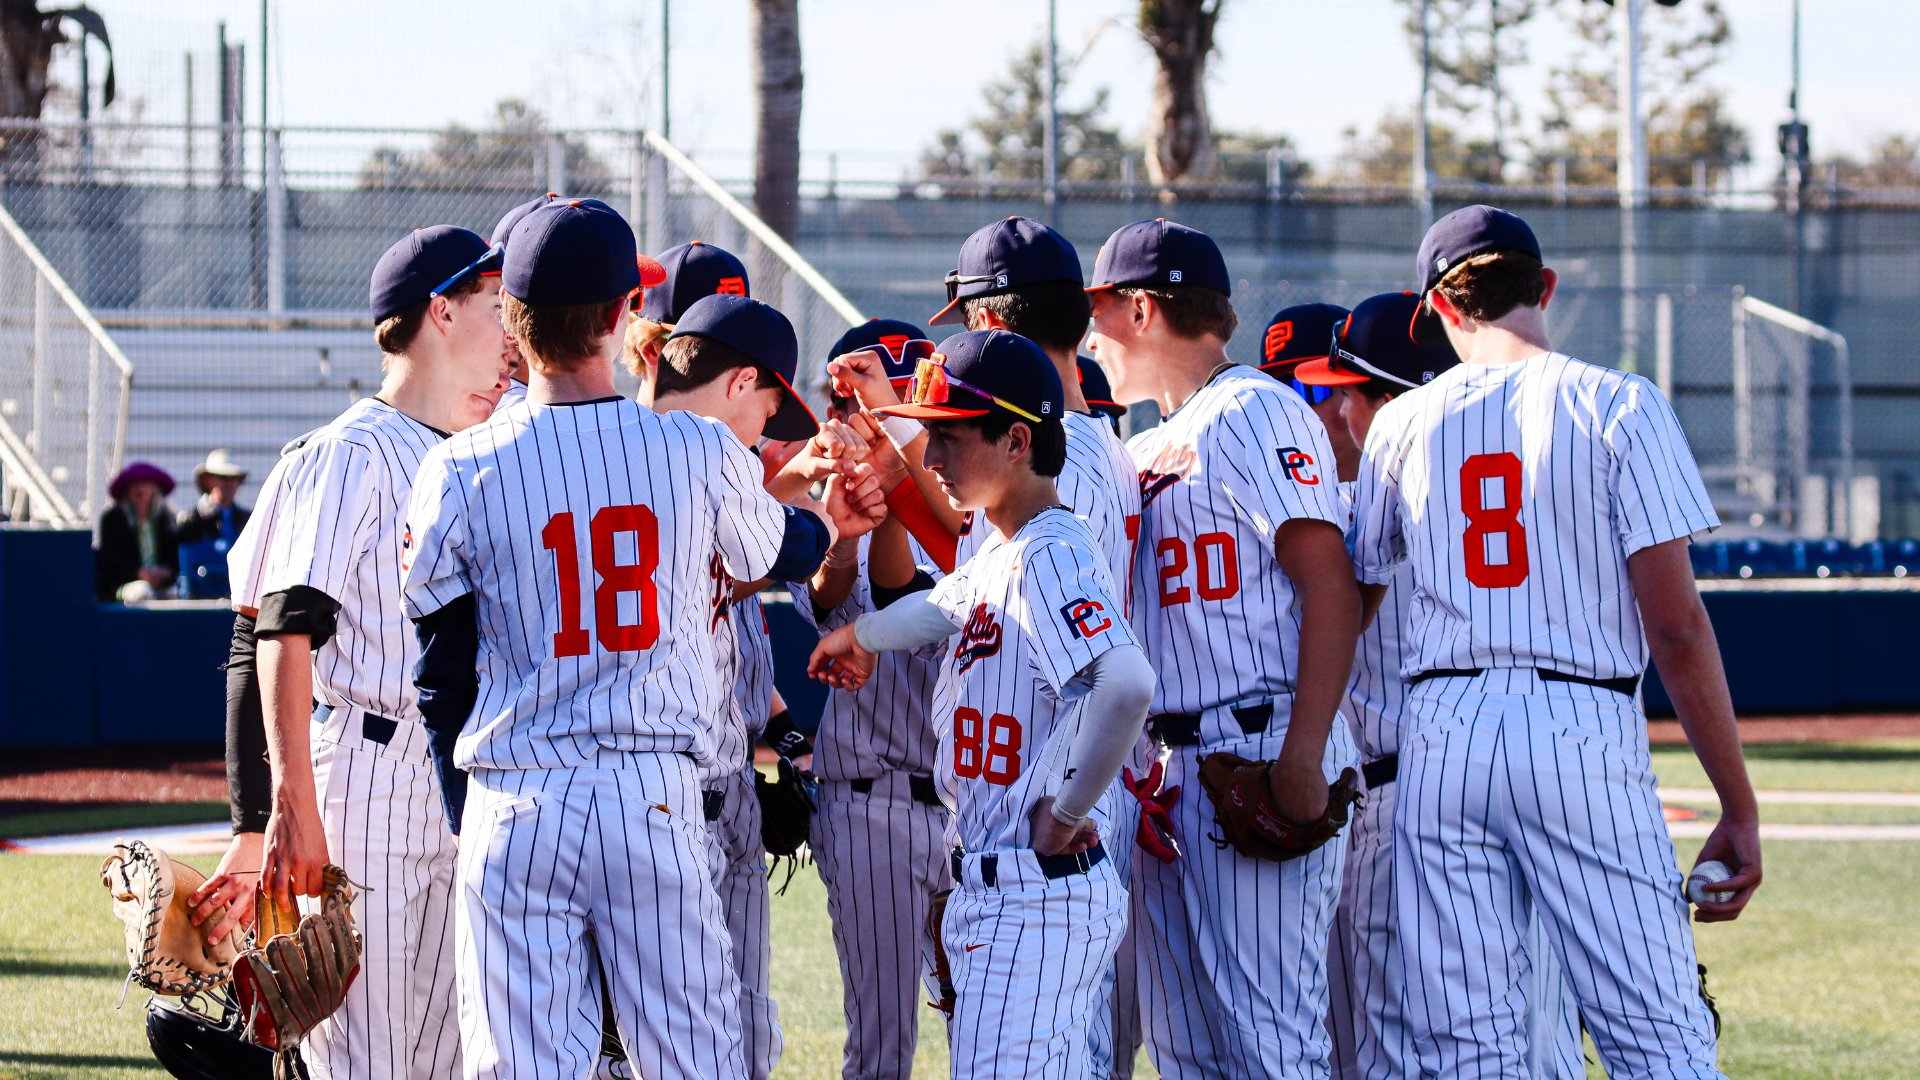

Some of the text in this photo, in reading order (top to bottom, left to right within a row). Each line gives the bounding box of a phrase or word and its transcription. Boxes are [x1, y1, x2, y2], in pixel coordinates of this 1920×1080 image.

[1276, 447, 1319, 485] PC
[1460, 452, 1529, 588] 8
[542, 504, 660, 658] 18
[1157, 532, 1239, 608] 20
[1060, 598, 1112, 640] PC
[954, 706, 1022, 786] 88
